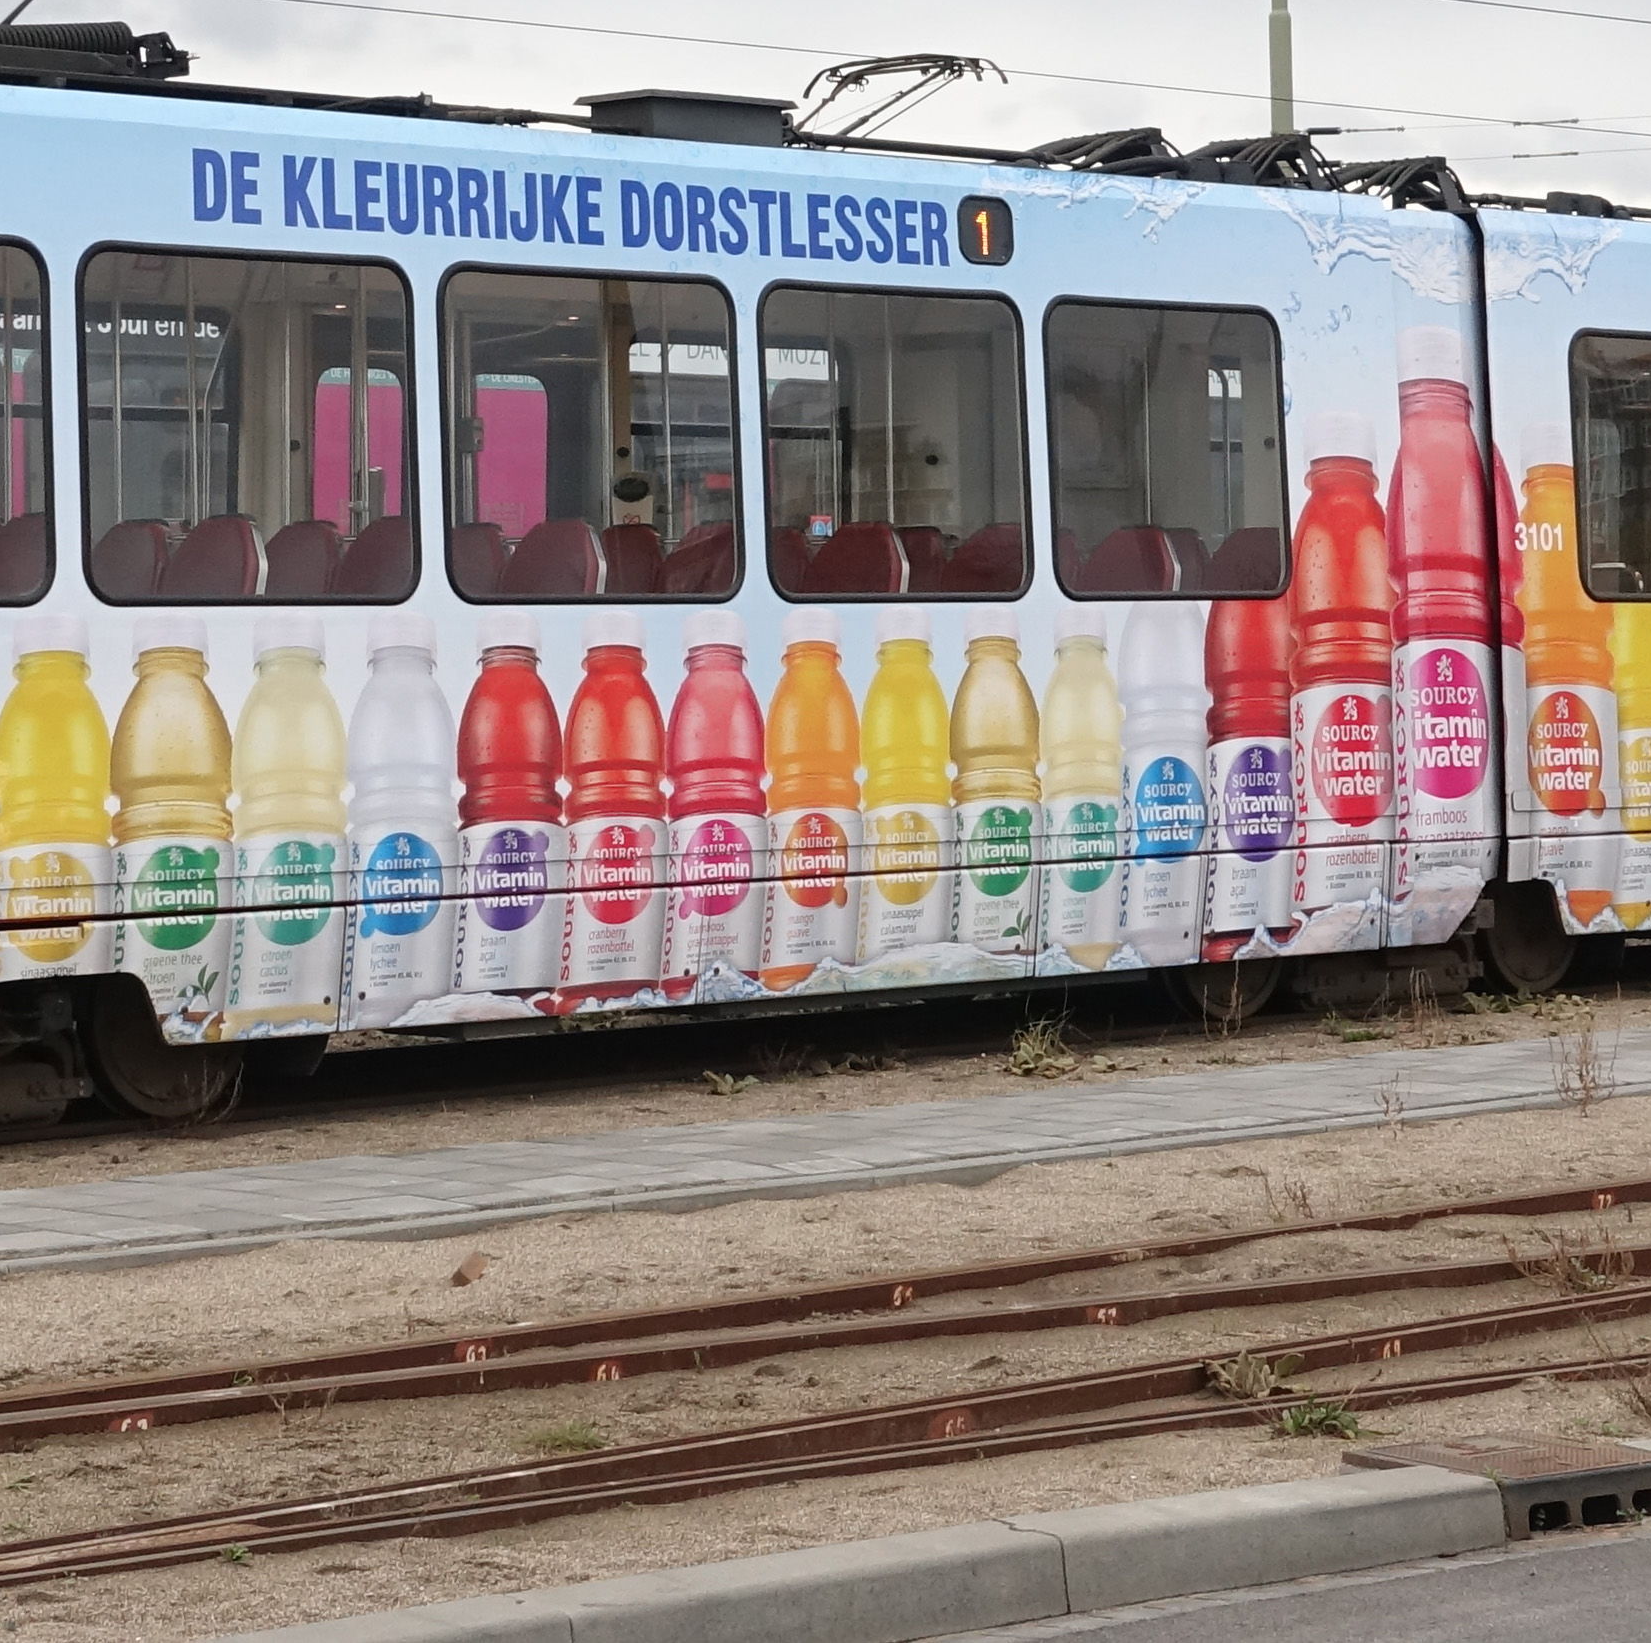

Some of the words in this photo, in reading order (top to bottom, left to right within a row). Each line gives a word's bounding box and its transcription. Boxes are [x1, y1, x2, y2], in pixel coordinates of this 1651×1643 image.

[192, 147, 262, 225] DE
[283, 154, 605, 246] KLEURRIJKE
[620, 179, 950, 267] DORSTLESSER
[974, 210, 989, 256] 1
[1515, 521, 1563, 552] 3101
[1409, 687, 1479, 707] SOURCY
[1321, 723, 1380, 744] SOURCY
[1536, 721, 1589, 739] SOURCY
[1413, 741, 1483, 769] water
[1231, 771, 1281, 788] SOURCY
[1322, 769, 1385, 798] water
[1536, 767, 1594, 791] water
[1143, 782, 1194, 798] SOURCY
[1232, 813, 1289, 836] water
[1414, 808, 1468, 828] framboos
[1144, 822, 1196, 842] water
[792, 836, 839, 850] SOURCY
[146, 868, 206, 882] SOURCY
